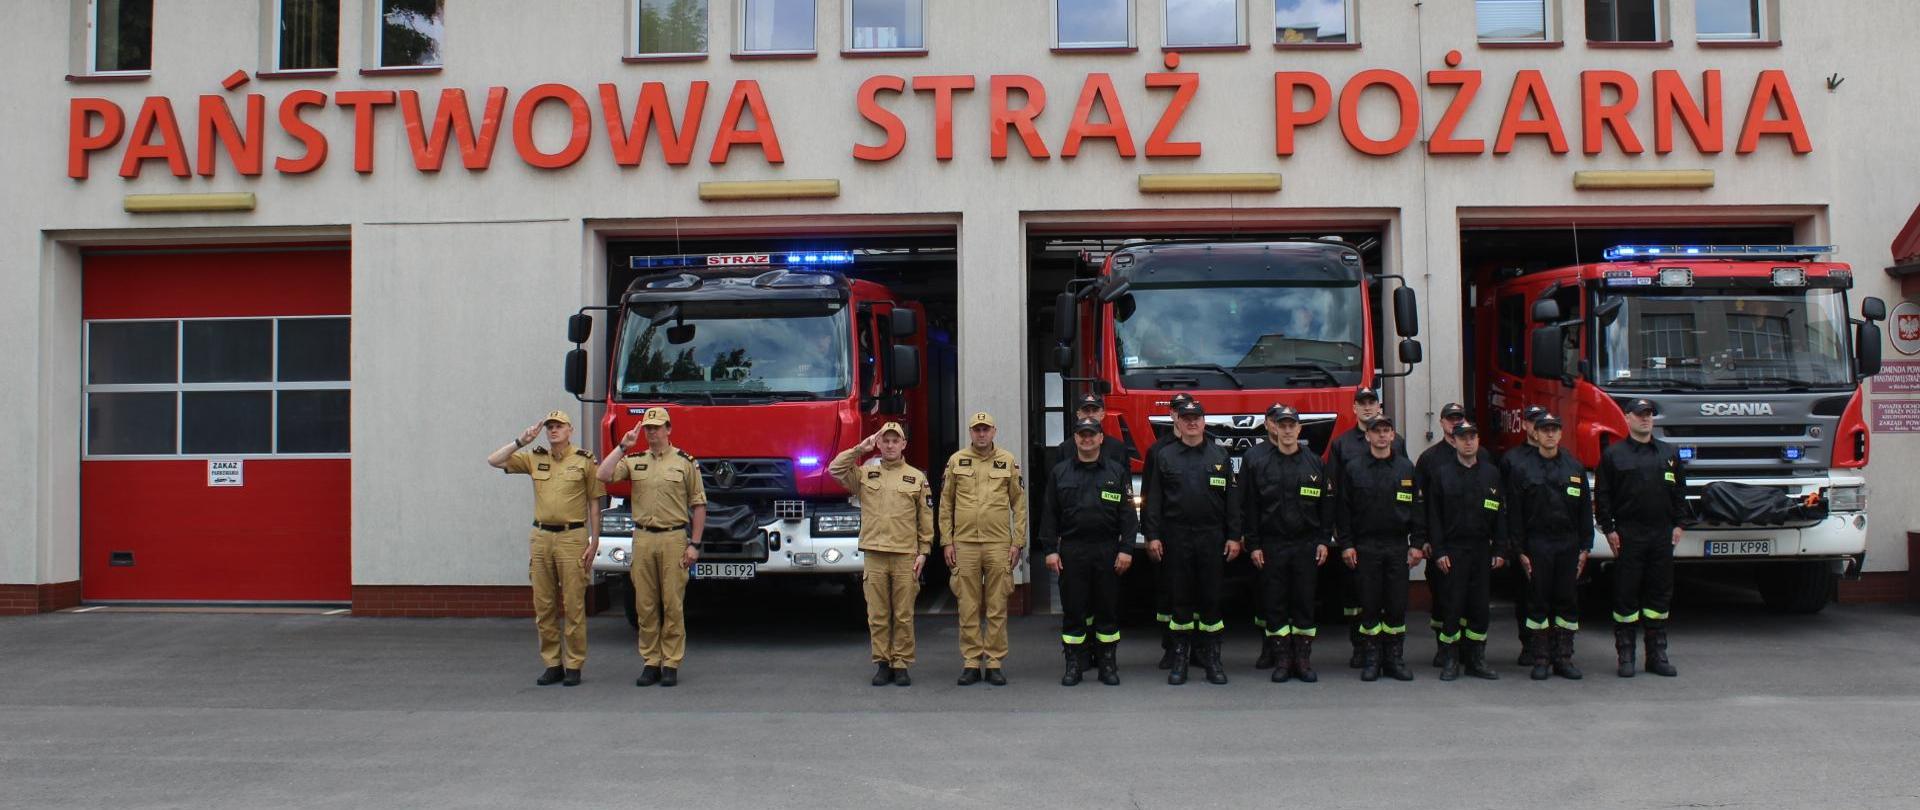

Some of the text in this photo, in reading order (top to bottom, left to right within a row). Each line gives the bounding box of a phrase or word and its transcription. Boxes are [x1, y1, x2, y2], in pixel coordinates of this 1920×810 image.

[68, 50, 1812, 180] PAŃSTWOWA STRAŻ POŻARNA
[1879, 365, 1906, 374] OMENDA
[1700, 402, 1773, 416] SCANIA
[1740, 542, 1769, 553] KP98
[724, 564, 753, 576] GT92
